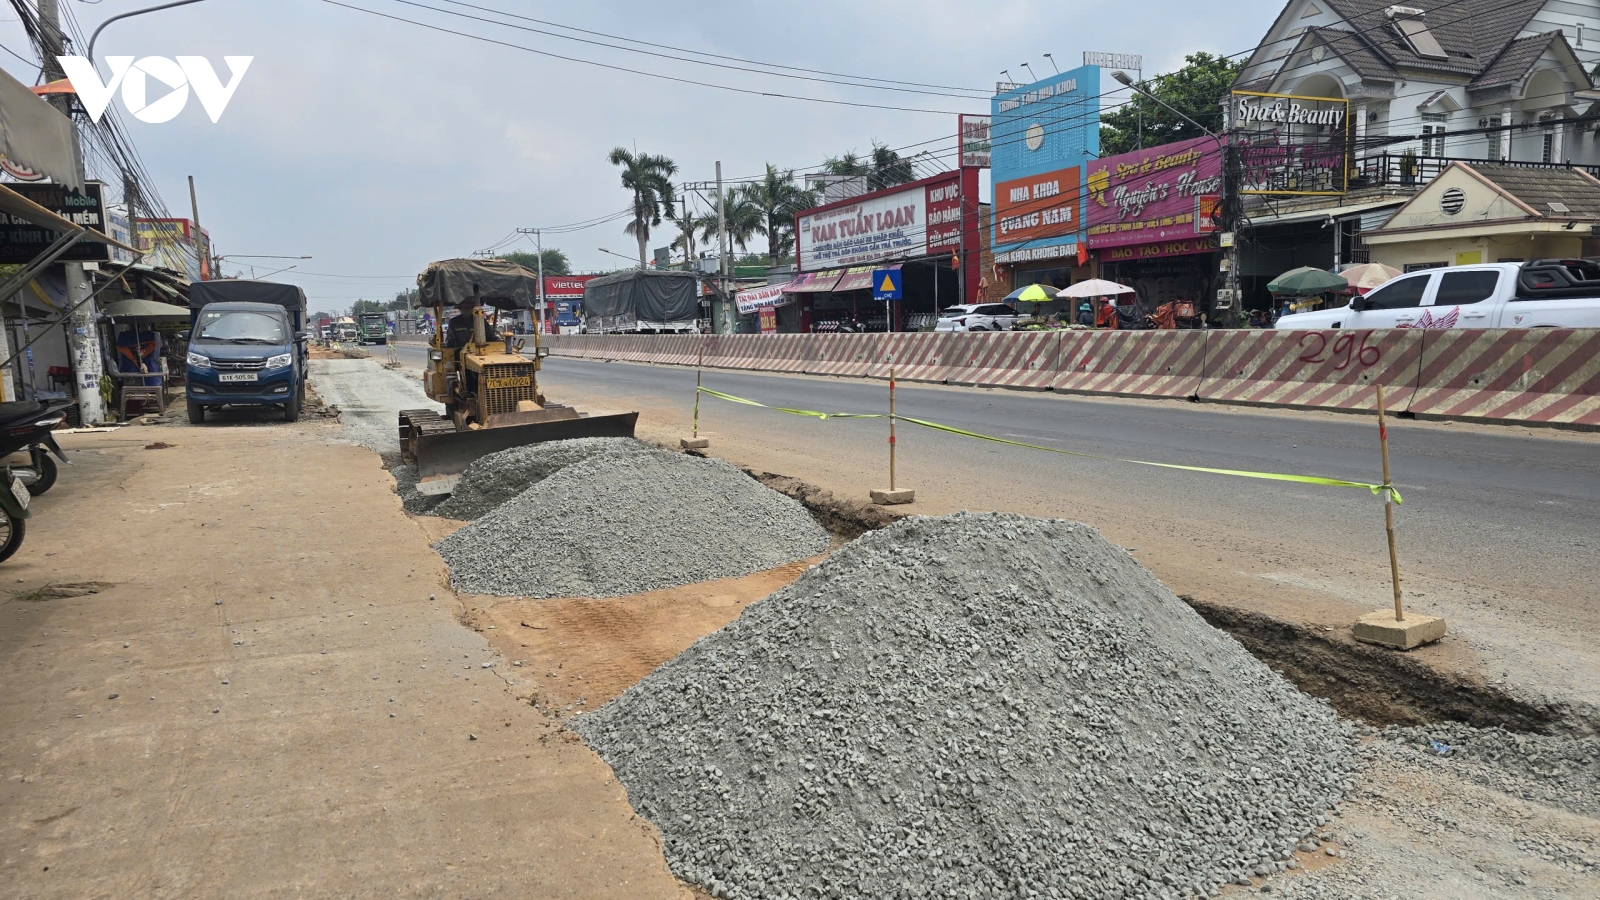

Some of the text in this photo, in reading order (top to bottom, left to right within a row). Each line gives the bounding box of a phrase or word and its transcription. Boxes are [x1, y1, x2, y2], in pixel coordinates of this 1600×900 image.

[998, 97, 1020, 113] TRUNG
[1038, 85, 1054, 100] NHA
[1056, 78, 1077, 95] KHOA
[1239, 98, 1344, 130] Spa & Beauty
[1115, 148, 1202, 180] Spa & Beauty
[930, 182, 959, 203] KHU VỰC
[1010, 180, 1059, 203] NHA KHOA
[1176, 170, 1221, 197] House
[65, 196, 97, 206] Mobile
[73, 210, 99, 225] MỀM
[811, 204, 916, 243] NAM TUẤN LOAN
[928, 207, 960, 226] BẢO HÀNH
[1042, 207, 1072, 225] NAM
[929, 230, 942, 248] SỬA
[1010, 249, 1031, 262] KHOA
[1032, 245, 1059, 260] KHÔNG
[1060, 244, 1077, 257] ĐAU
[1140, 245, 1160, 257] TẠO
[1165, 241, 1190, 255] HỌC
[552, 281, 584, 289] viettel
[738, 295, 747, 303] TẠI
[748, 293, 757, 302] ĐÂY
[758, 291, 769, 300] BÁN
[761, 312, 776, 329] SỬA XE
[1299, 328, 1380, 370] 296
